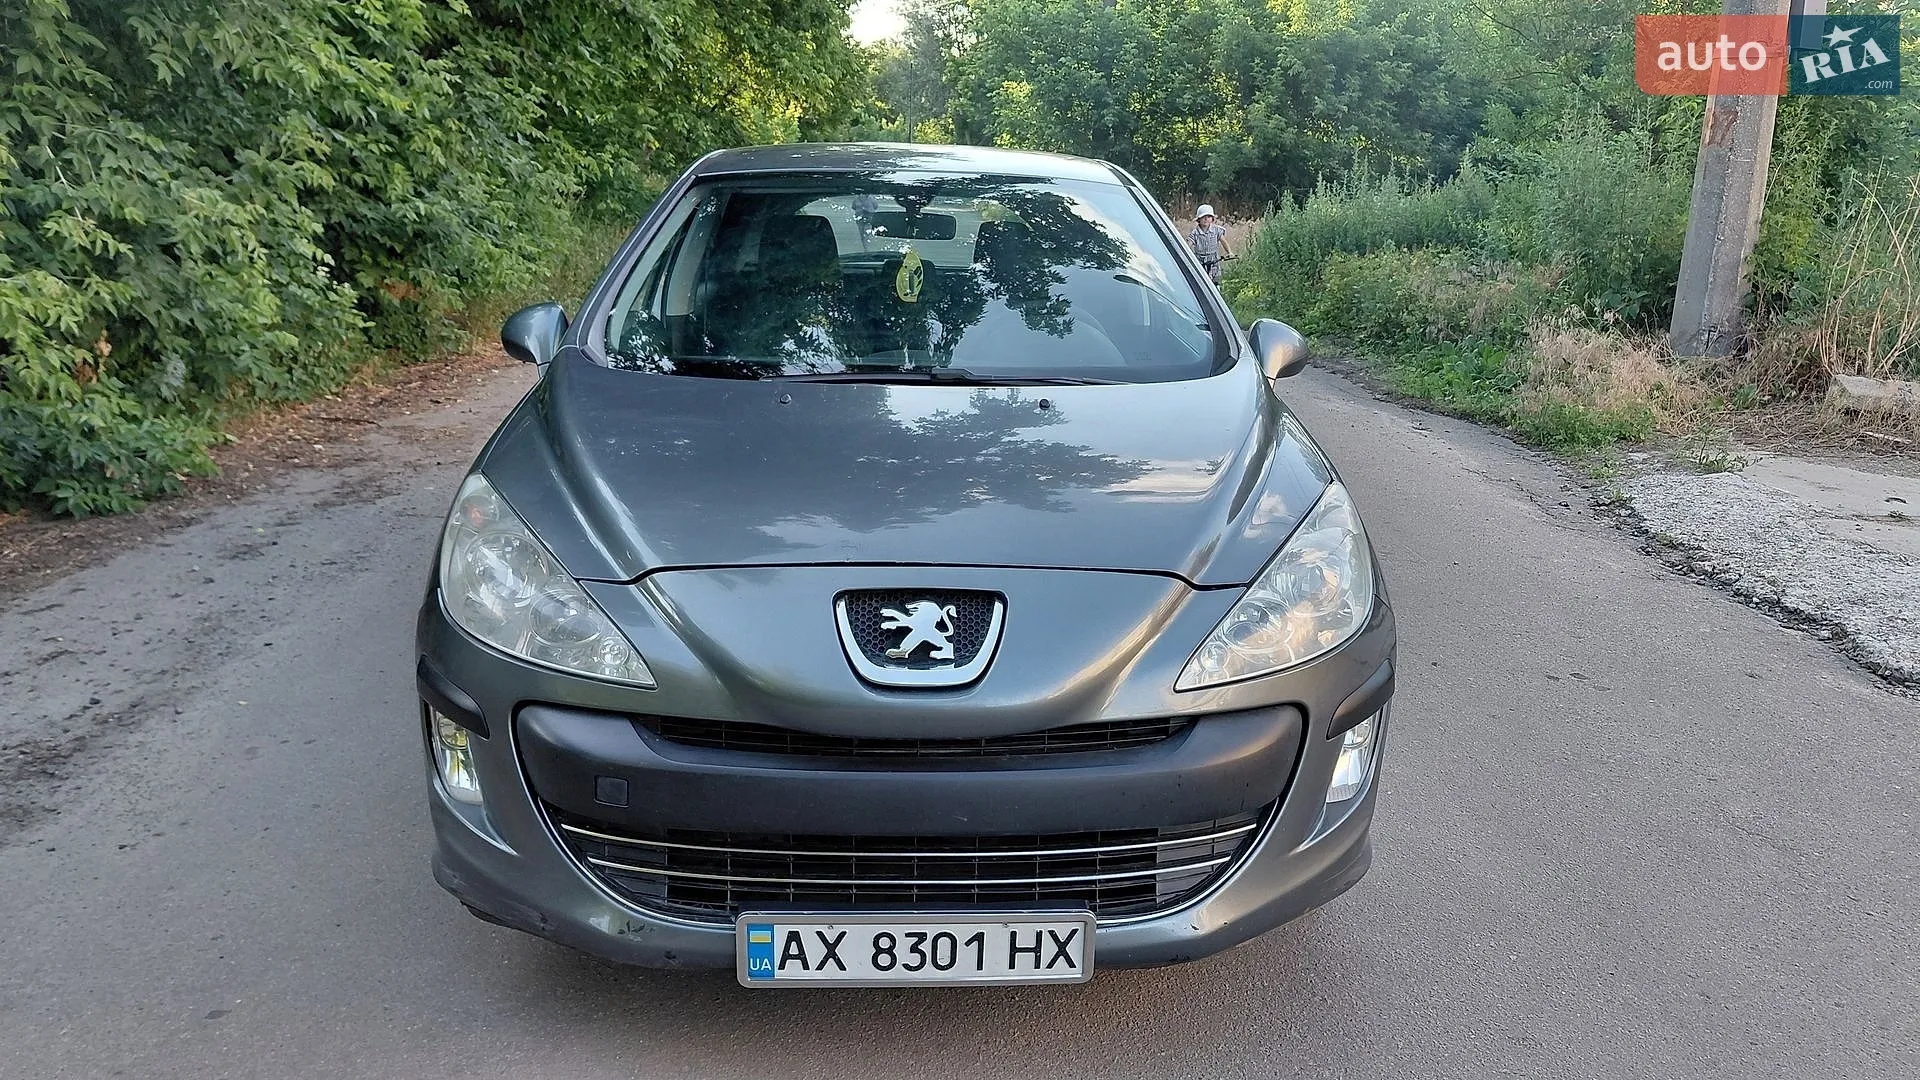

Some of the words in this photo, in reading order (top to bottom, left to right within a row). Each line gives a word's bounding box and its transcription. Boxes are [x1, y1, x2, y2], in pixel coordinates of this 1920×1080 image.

[750, 957, 771, 971] UA
[777, 930, 848, 972] AX
[870, 931, 985, 973] 8301
[1008, 928, 1080, 971] HX
